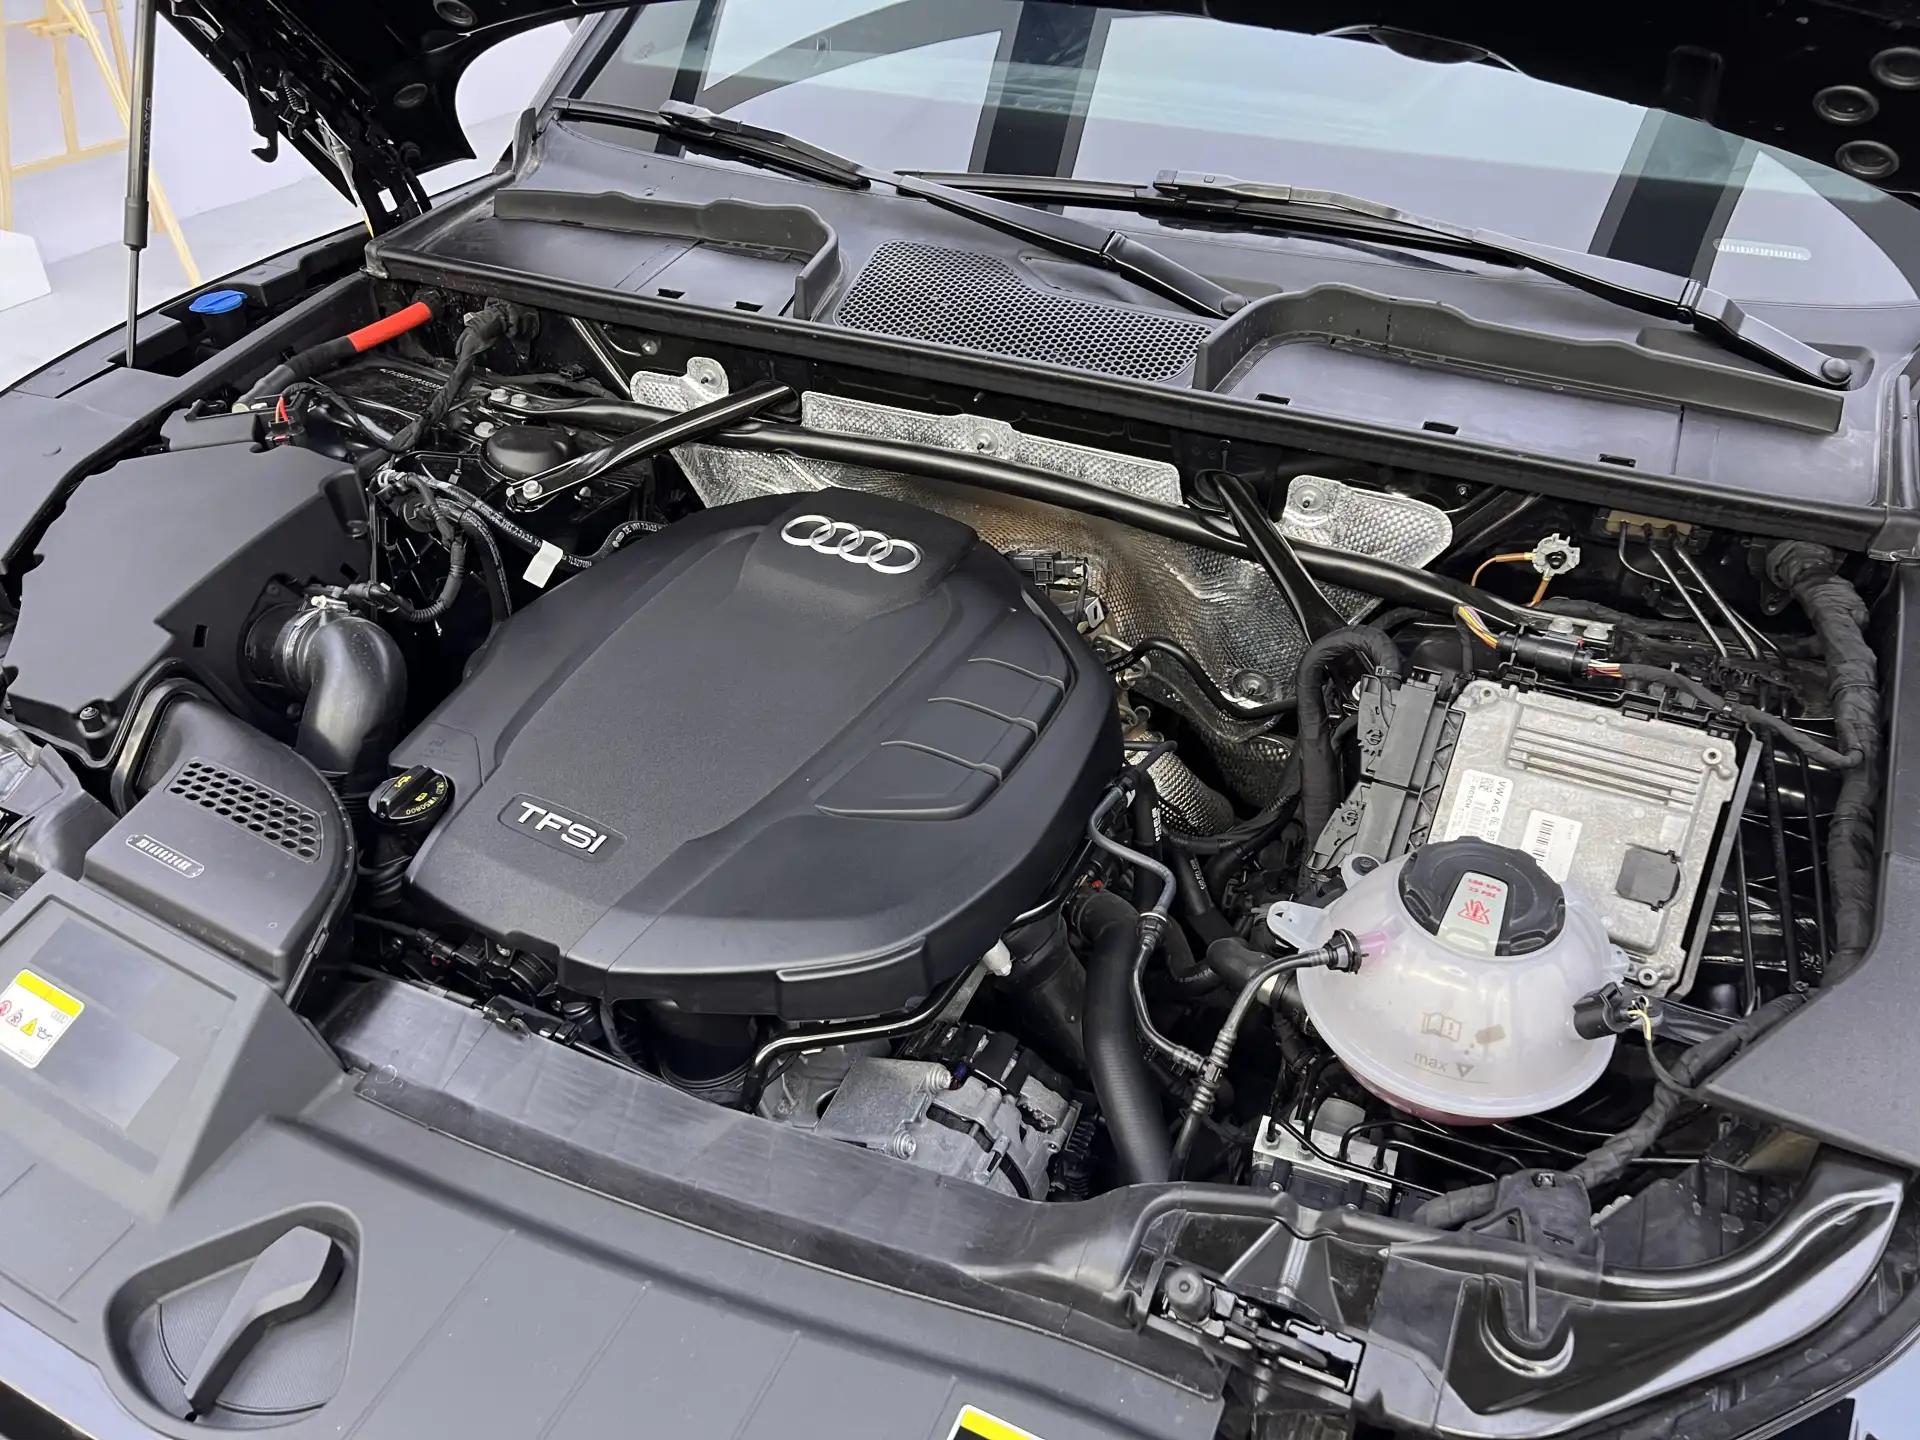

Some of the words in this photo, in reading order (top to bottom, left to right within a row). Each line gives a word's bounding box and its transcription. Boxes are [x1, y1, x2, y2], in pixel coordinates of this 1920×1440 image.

[1496, 781, 1508, 797] VW
[1491, 798, 1501, 813] AG
[517, 801, 608, 854] TFSI
[1414, 1052, 1448, 1073] max
